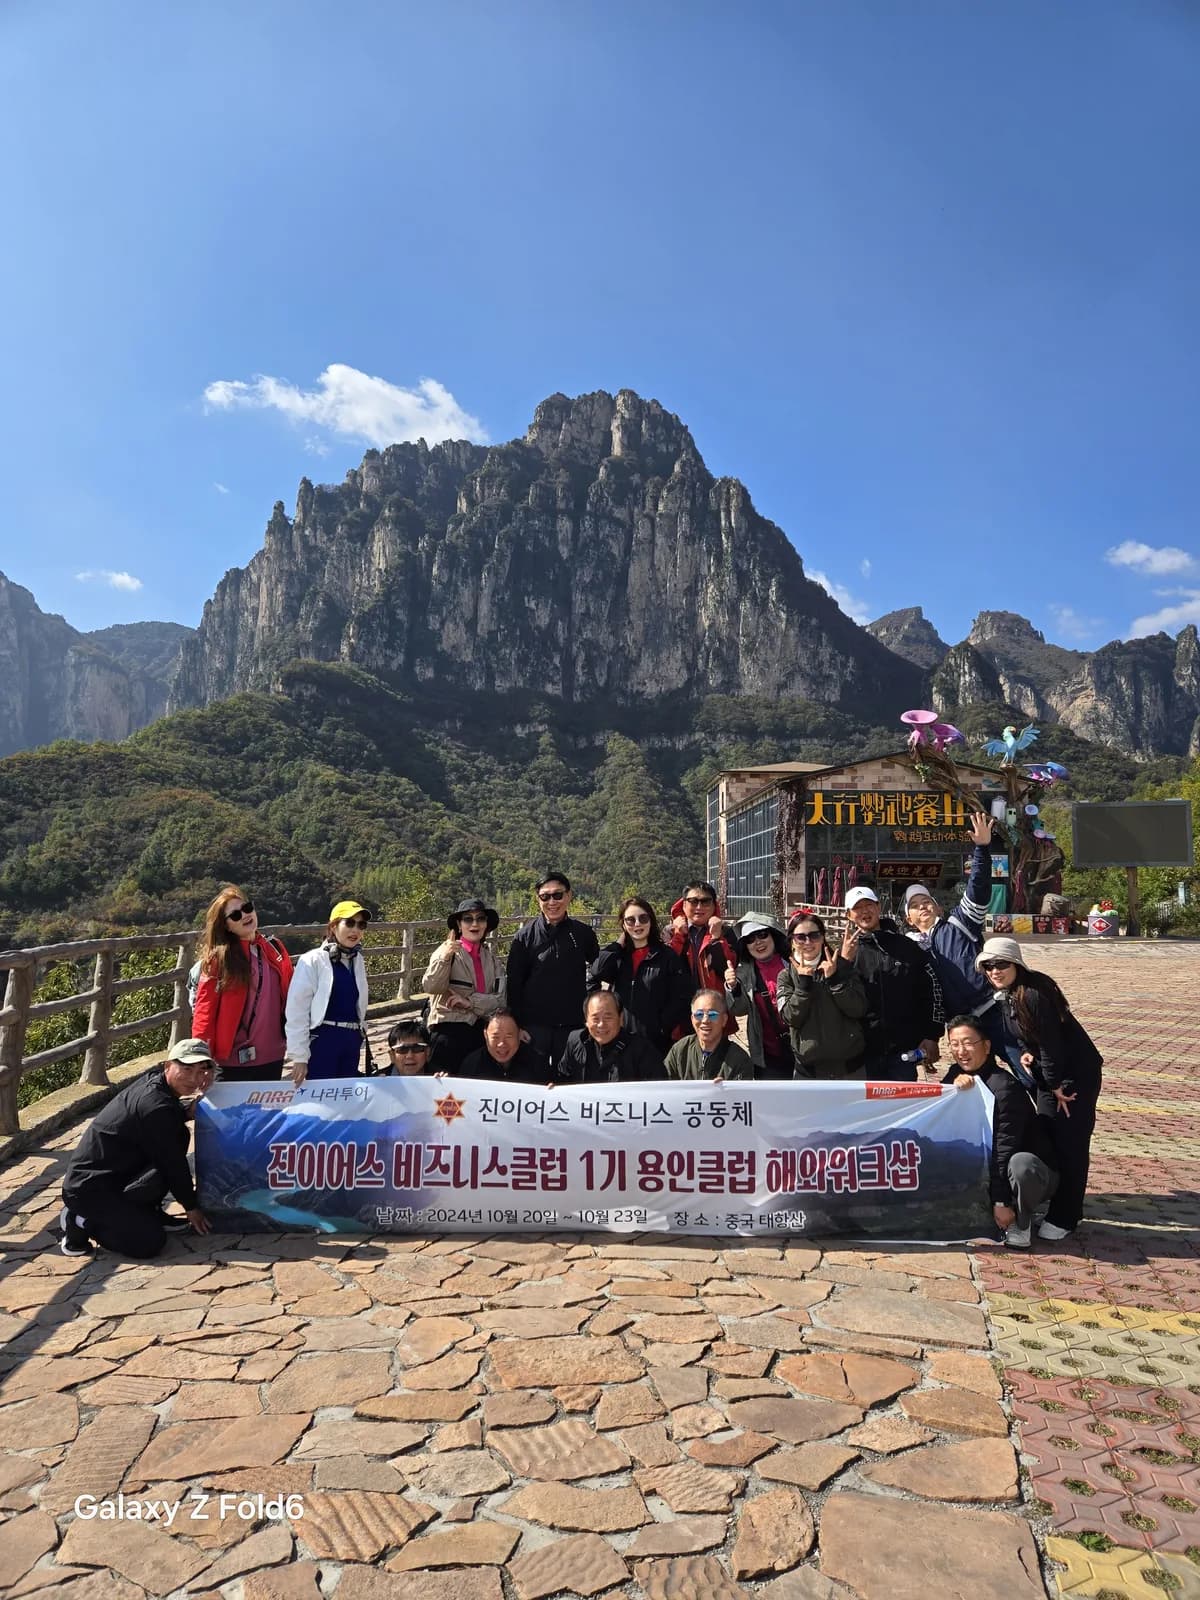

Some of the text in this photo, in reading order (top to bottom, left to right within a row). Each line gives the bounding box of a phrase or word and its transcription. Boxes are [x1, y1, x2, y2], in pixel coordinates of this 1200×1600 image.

[311, 1086, 369, 1102] 나라투어
[478, 1097, 753, 1128] 진이어스 비즈니스 공동체
[268, 1140, 921, 1194] 진이어스 비즈니스클럽 1기 용인클럽 해외워크샵
[427, 1208, 484, 1224] 2024년
[488, 1209, 519, 1225] 10월
[523, 1209, 558, 1225] 20일
[613, 1209, 648, 1224] 23일
[724, 1213, 754, 1230] 중국
[759, 1210, 806, 1229] 태항산
